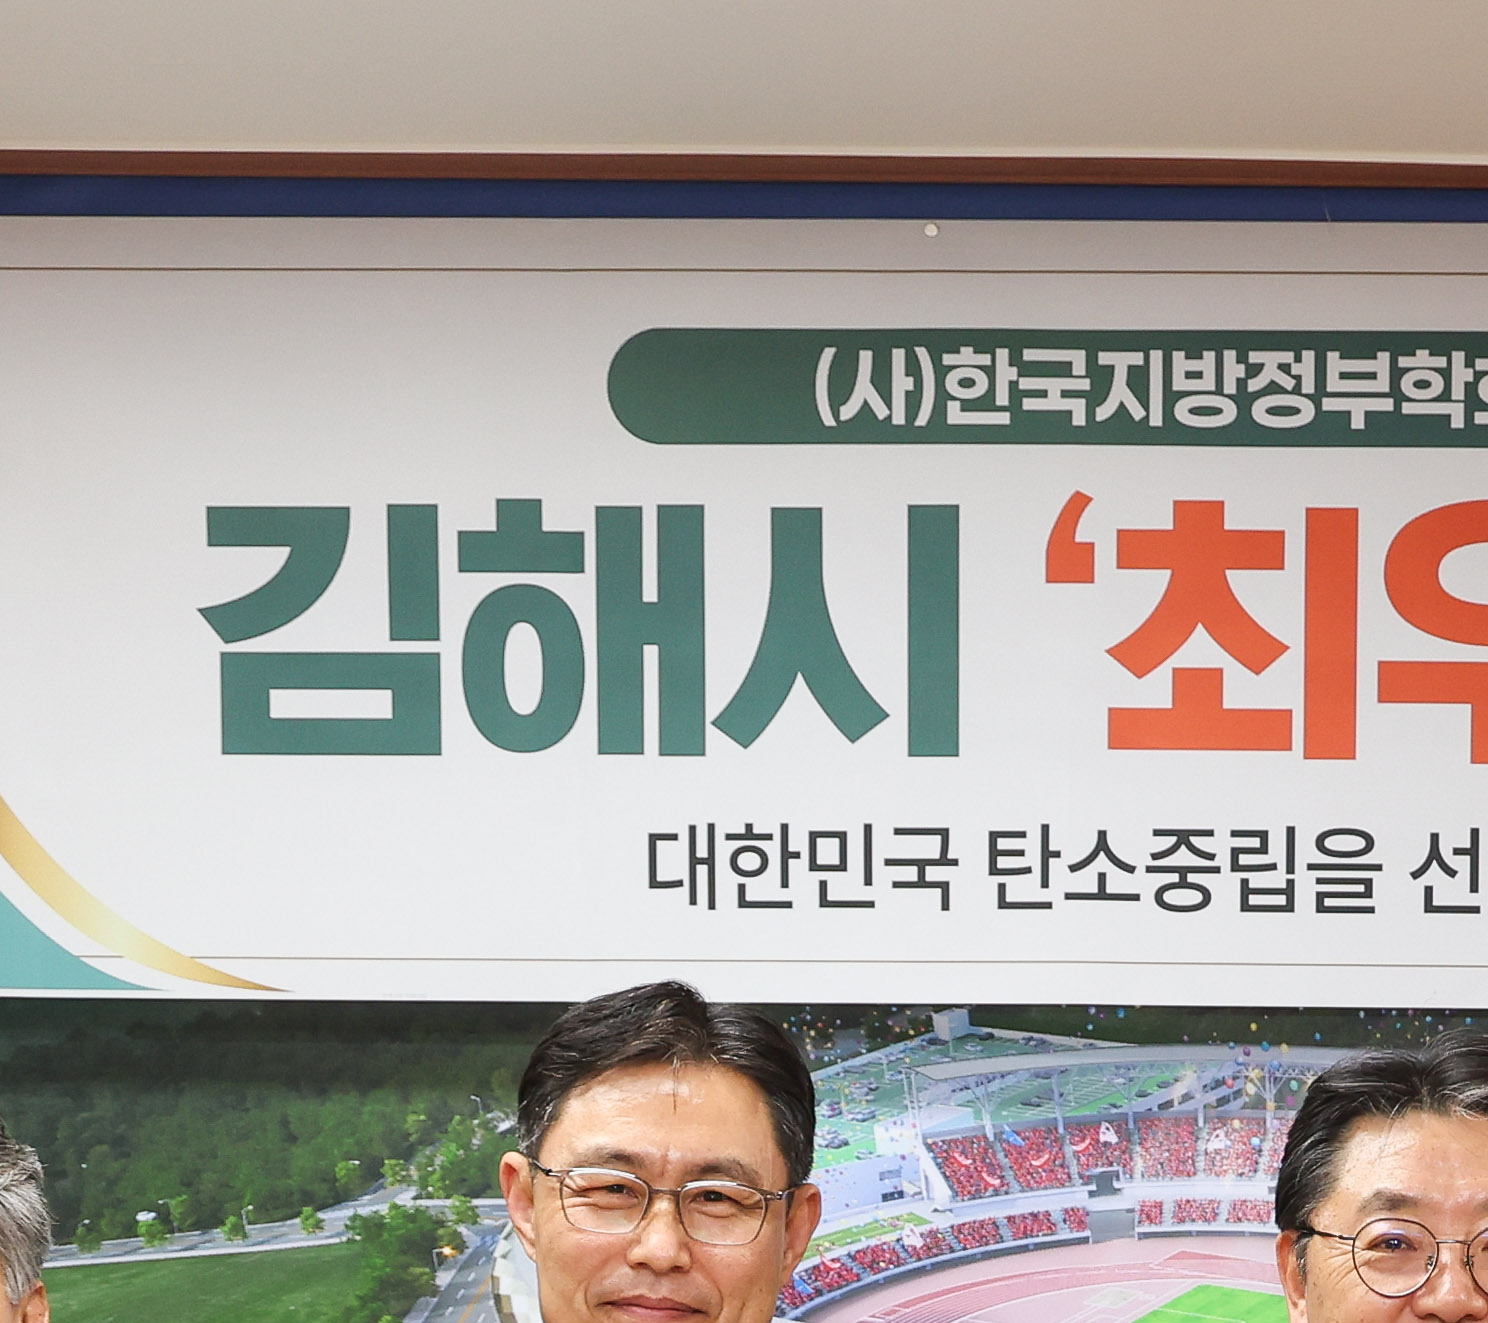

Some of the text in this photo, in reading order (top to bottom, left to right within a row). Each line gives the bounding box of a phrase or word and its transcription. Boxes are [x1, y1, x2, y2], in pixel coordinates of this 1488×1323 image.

[196, 498, 962, 759] 김해시
[648, 822, 961, 912] 대한민국
[987, 825, 1385, 917] 탄소중립을
